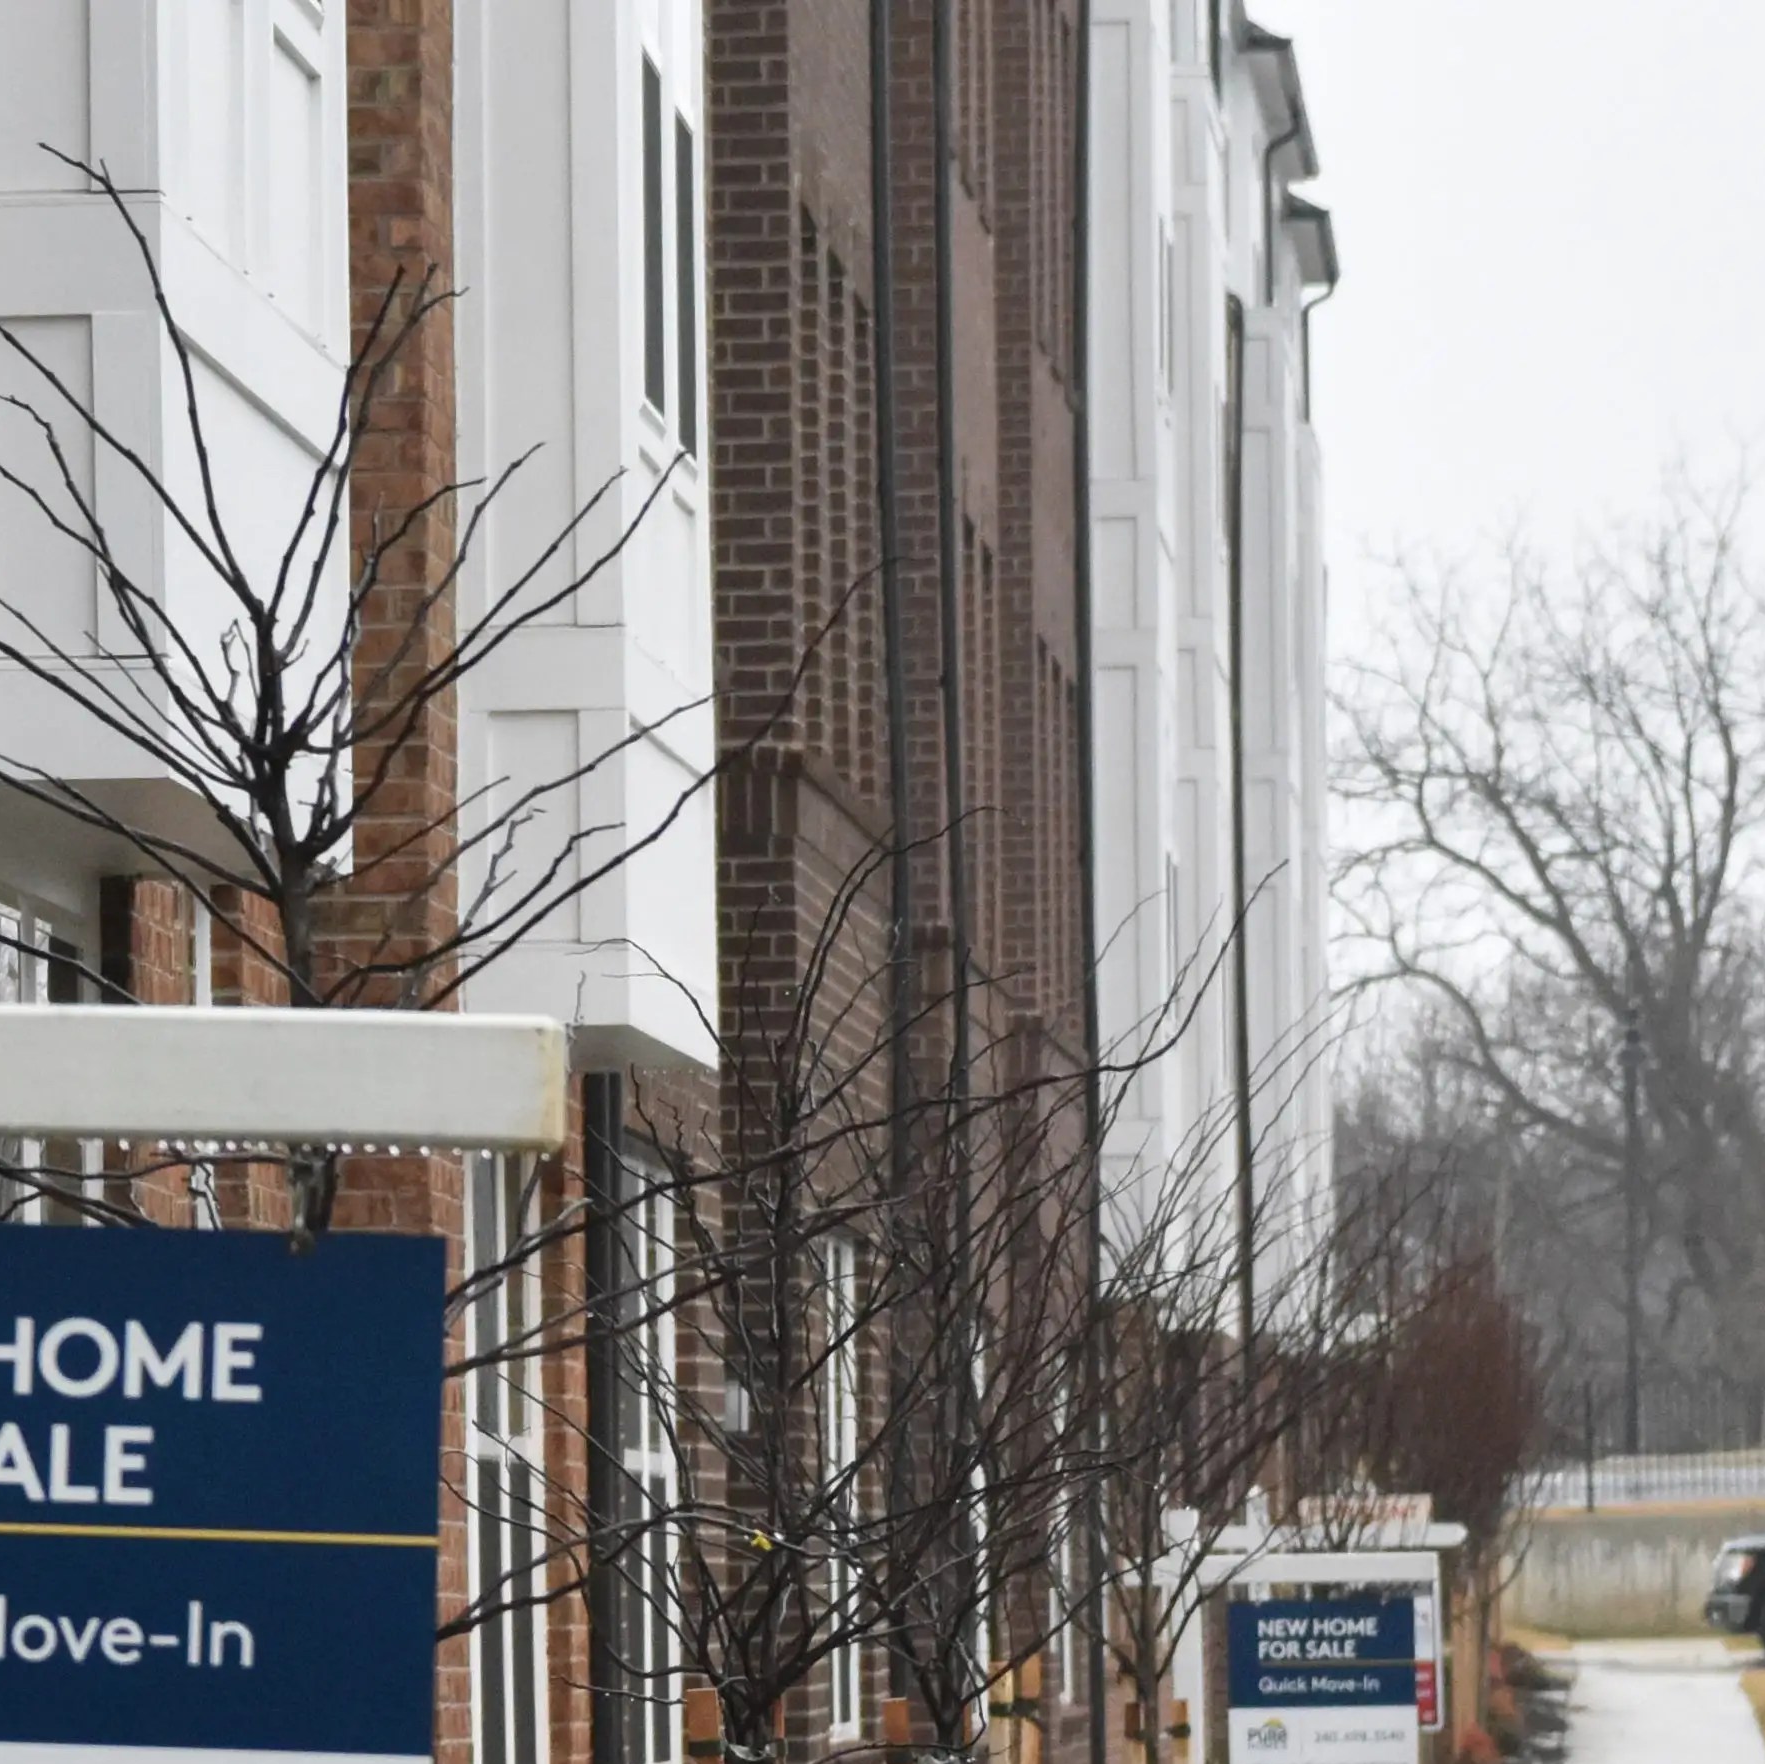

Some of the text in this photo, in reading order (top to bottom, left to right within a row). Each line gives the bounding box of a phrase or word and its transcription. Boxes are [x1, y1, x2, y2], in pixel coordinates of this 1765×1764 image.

[1257, 1616, 1378, 1638] NEW HOME
[1258, 1638, 1356, 1660] FOR SALE
[1258, 1674, 1380, 1694] Quick Move-In
